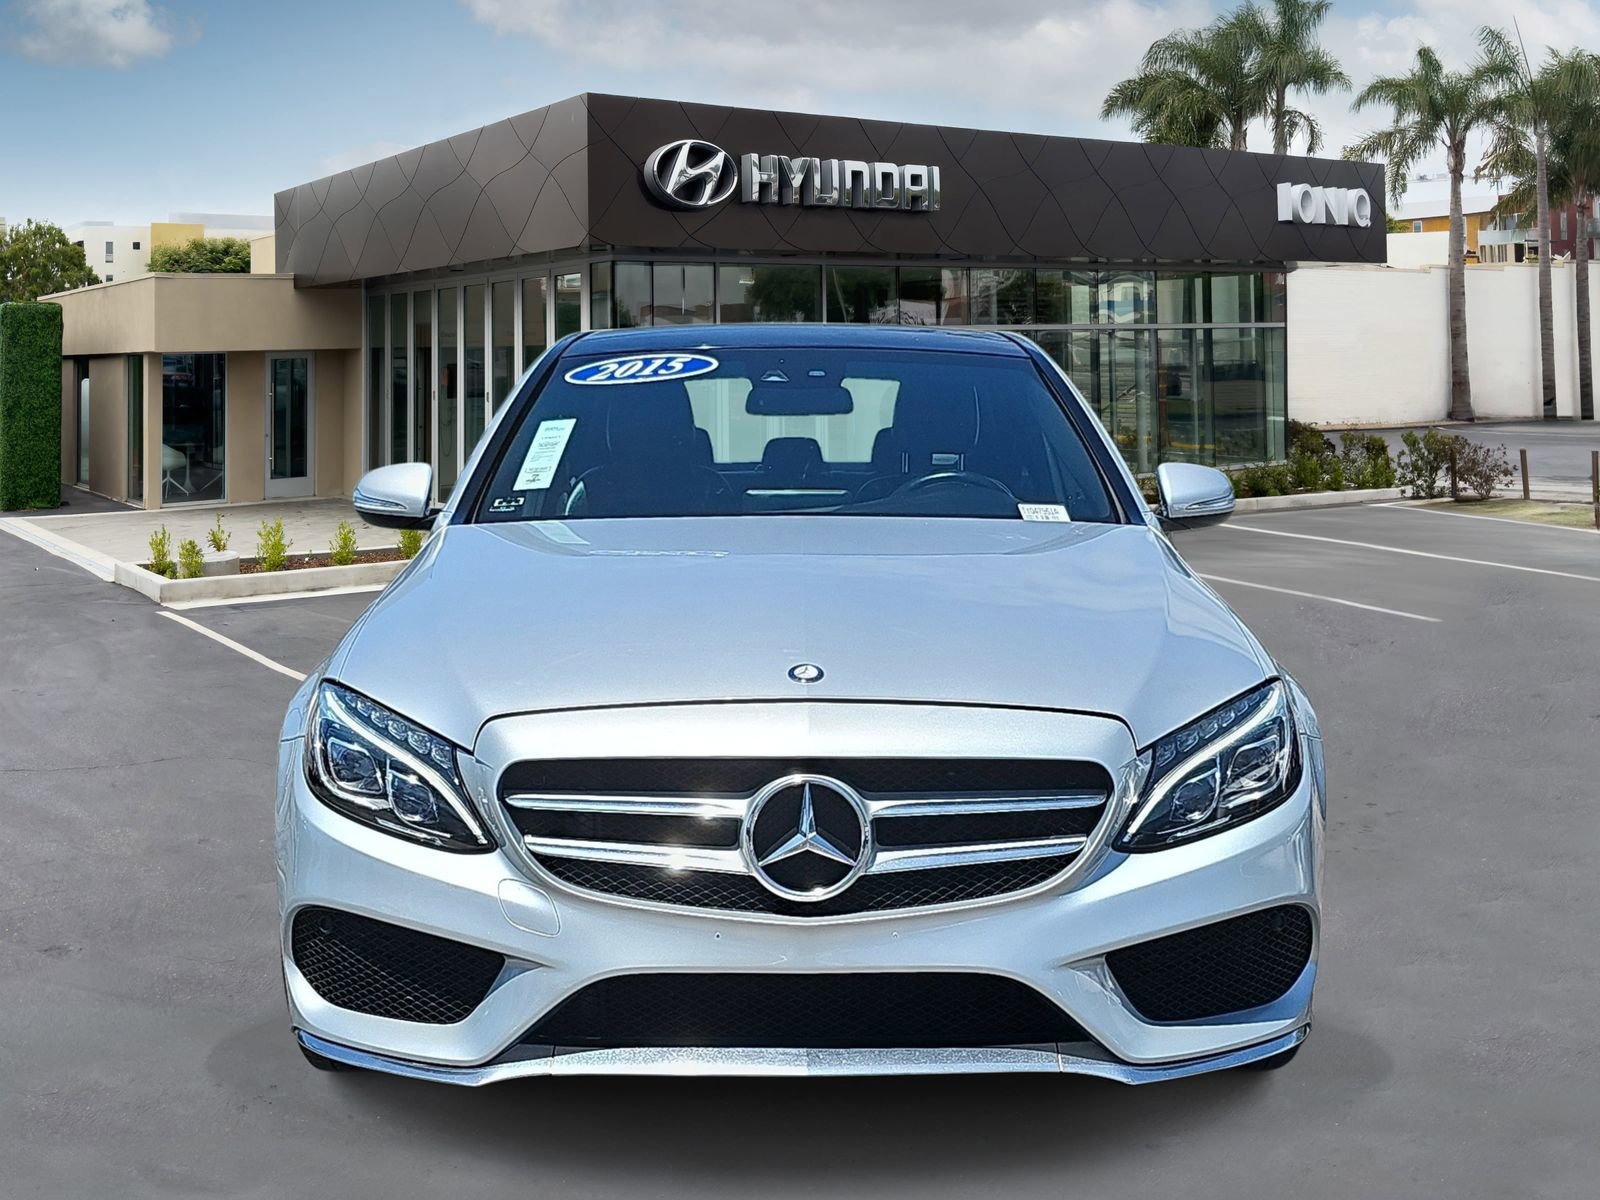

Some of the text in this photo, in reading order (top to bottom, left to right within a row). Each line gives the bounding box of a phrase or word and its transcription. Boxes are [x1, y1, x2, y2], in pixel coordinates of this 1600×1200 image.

[741, 152, 941, 212] HYUNDAI
[1276, 182, 1372, 228] IONIQ
[586, 357, 692, 381] 2015
